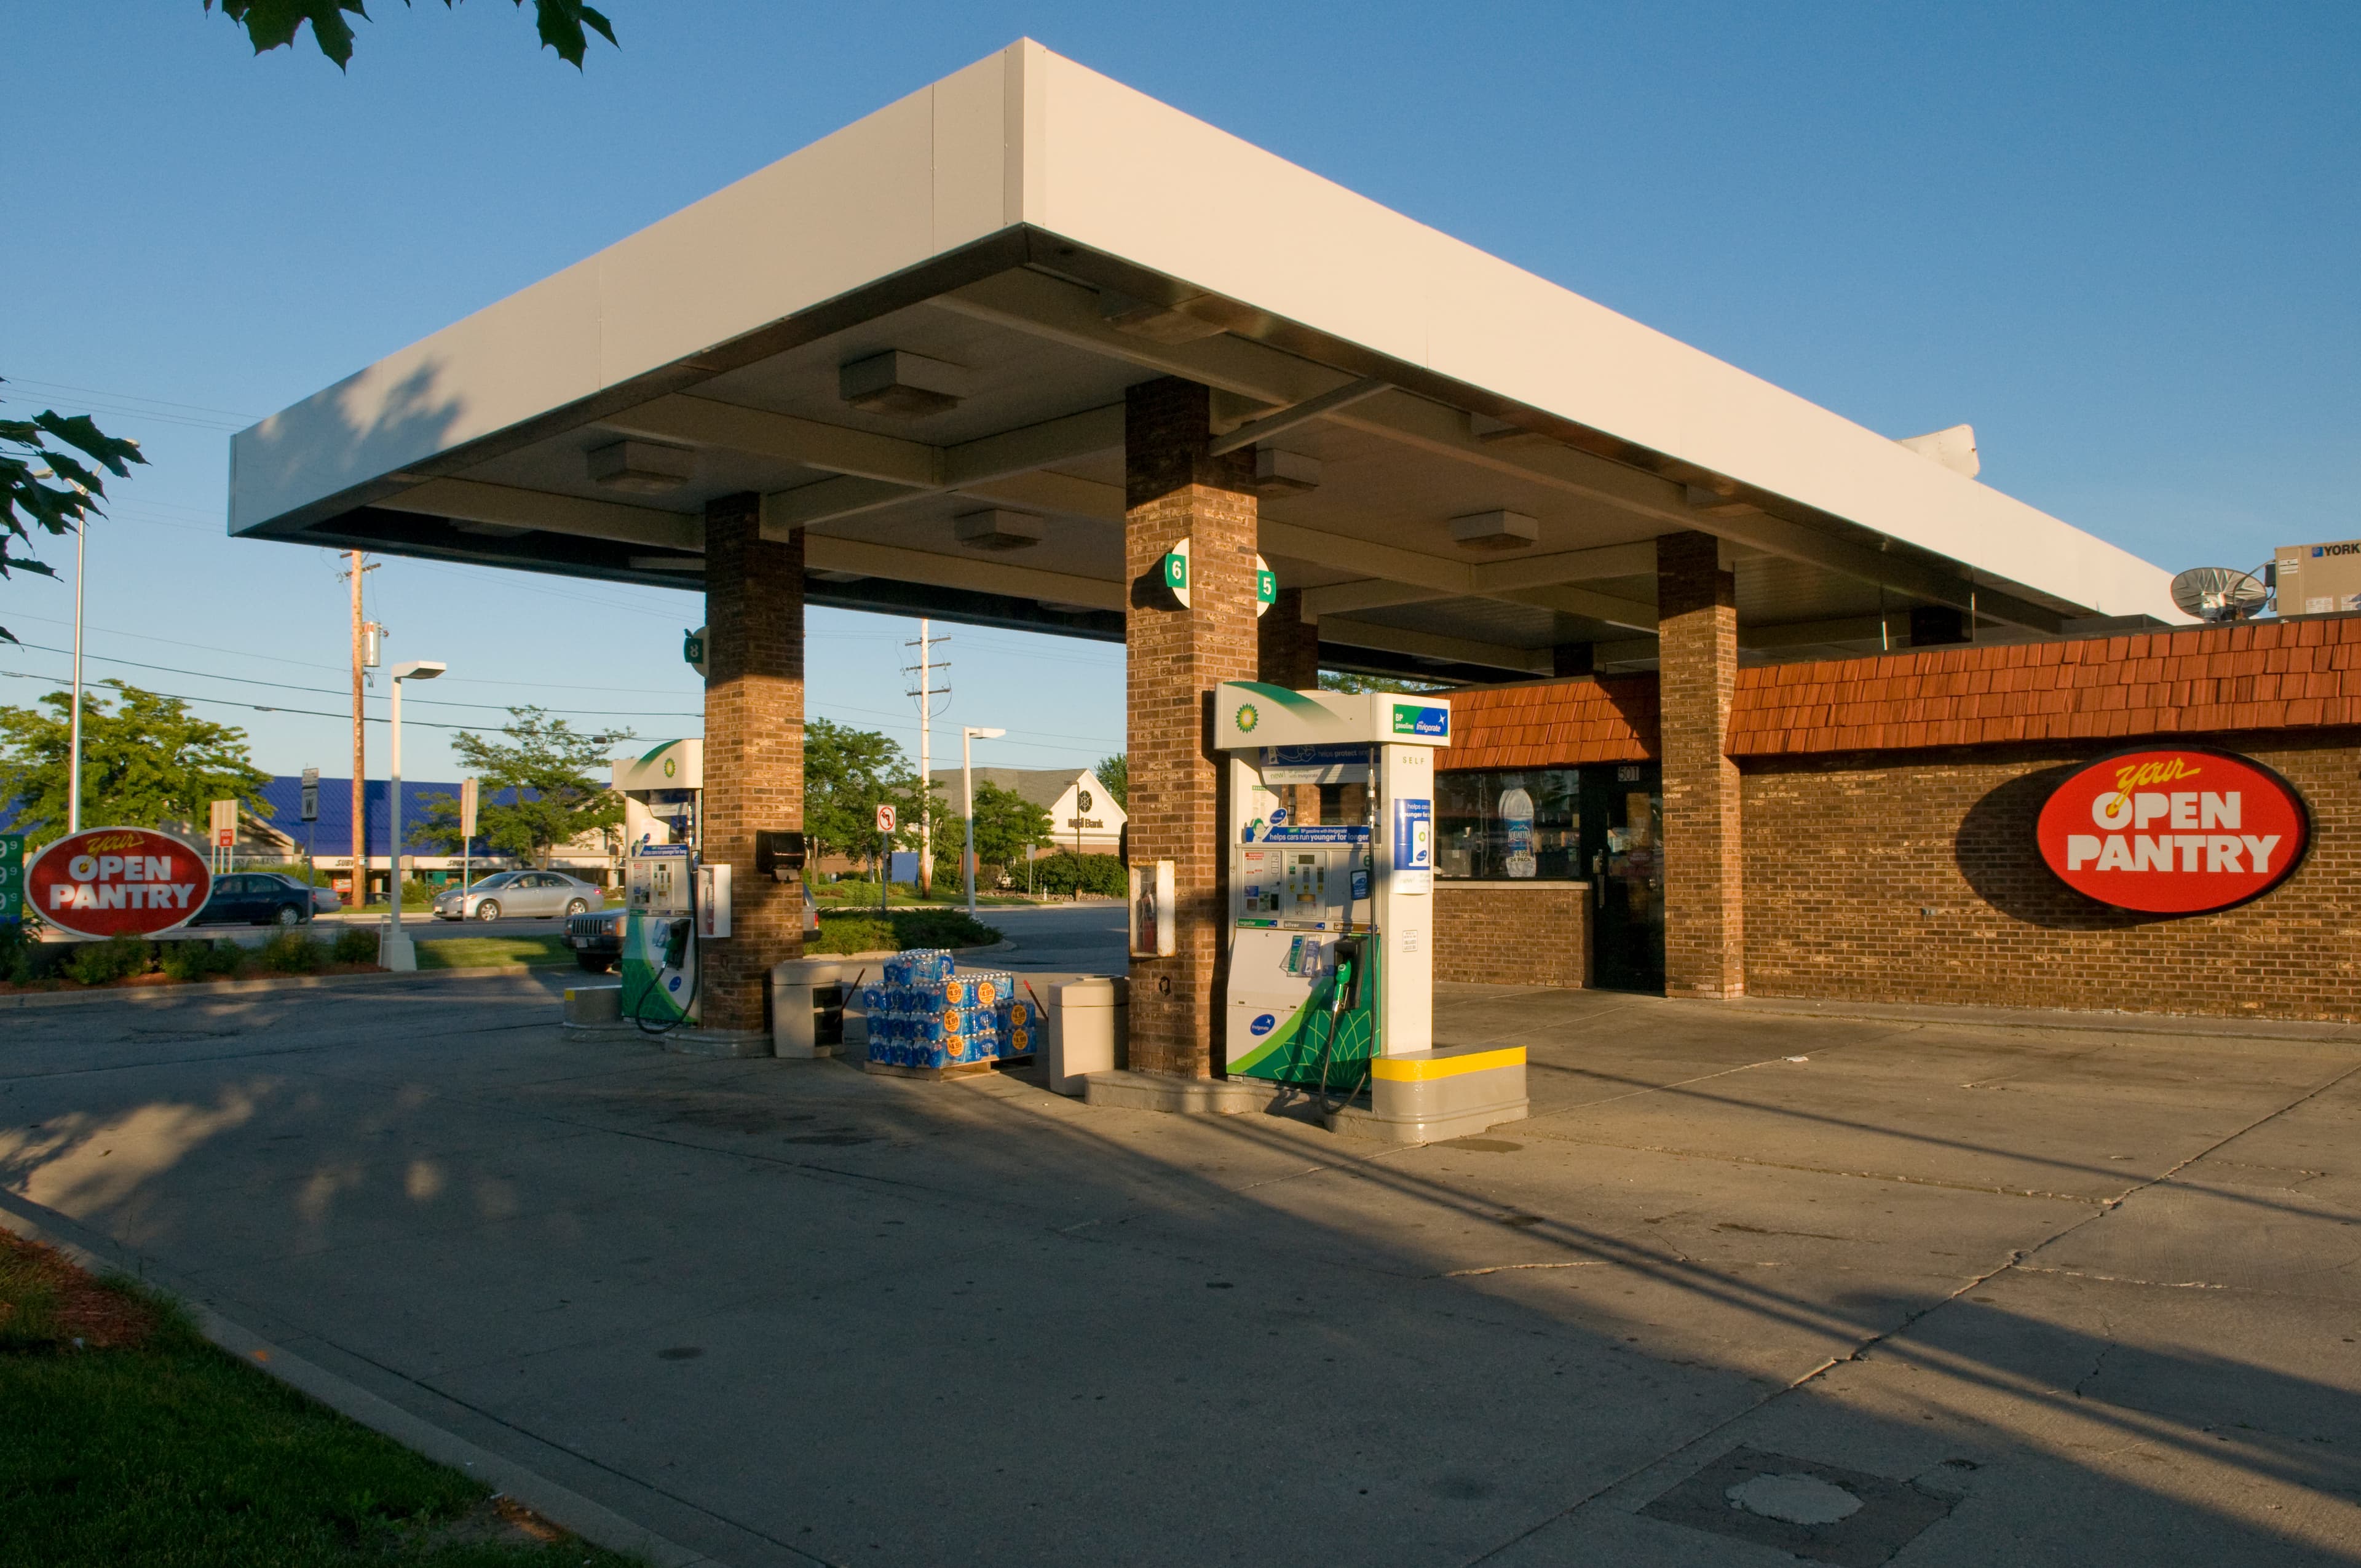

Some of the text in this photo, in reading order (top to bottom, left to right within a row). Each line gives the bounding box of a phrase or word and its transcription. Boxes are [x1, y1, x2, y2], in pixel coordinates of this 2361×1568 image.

[2325, 544, 2360, 556] YORK
[1173, 561, 1182, 580] 6
[1263, 577, 1271, 595] 5
[1270, 770, 1286, 779] new!
[1618, 767, 1638, 780] 501
[2106, 757, 2201, 815] your
[306, 799, 314, 814] W
[2092, 791, 2241, 830] OPEN
[1085, 818, 1104, 828] Bank
[1270, 833, 1286, 842] helps
[1348, 833, 1369, 842] longer
[79, 833, 144, 871] your
[2067, 834, 2282, 873] PANTRY
[69, 855, 172, 881] OPEN
[50, 884, 196, 909] PANTRY
